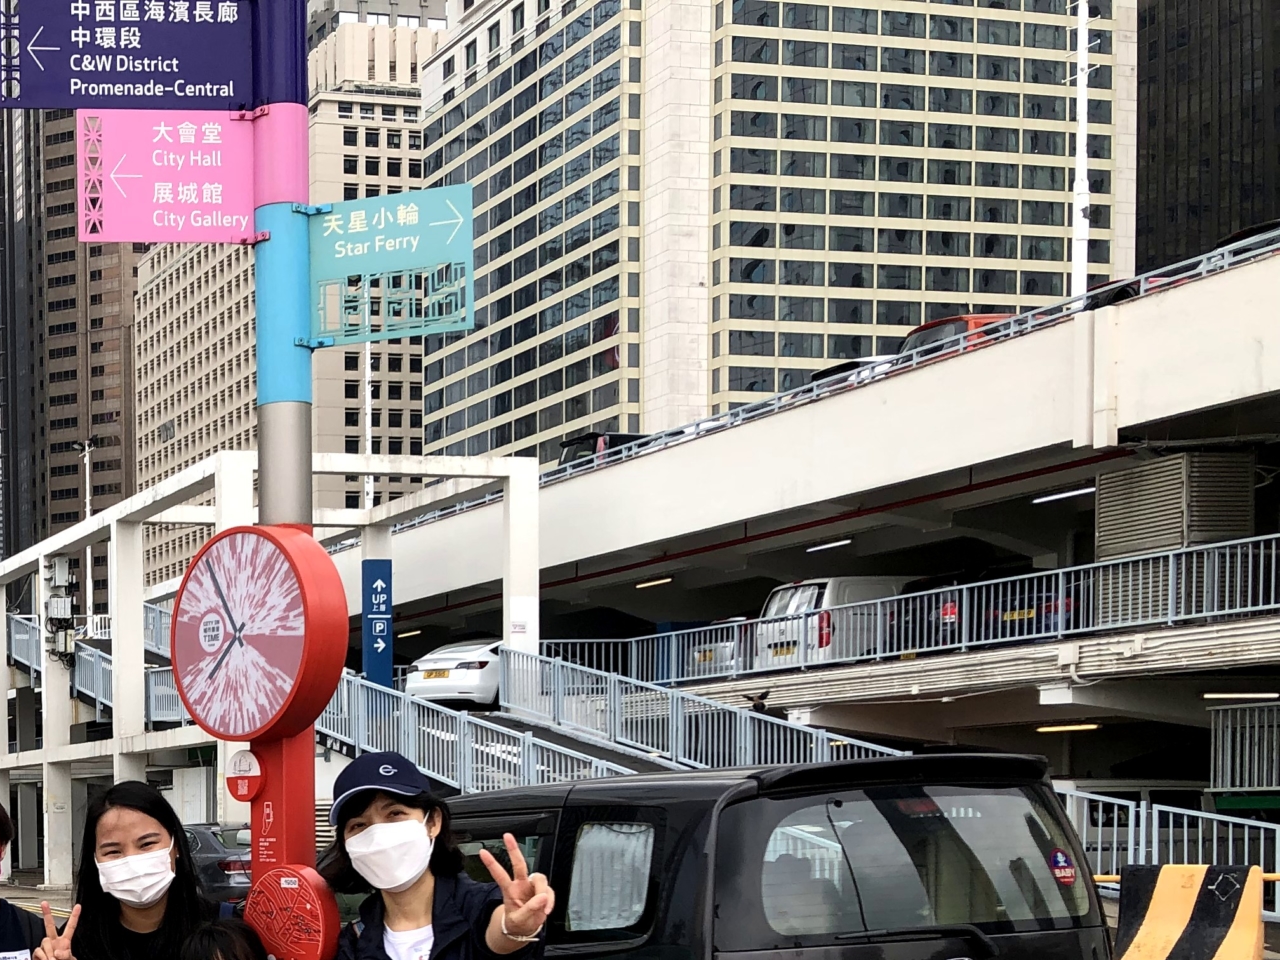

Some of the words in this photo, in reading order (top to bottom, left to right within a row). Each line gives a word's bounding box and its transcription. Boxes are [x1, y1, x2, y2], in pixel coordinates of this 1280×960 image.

[70, 0, 238, 23] 中西區海濱長廊
[70, 26, 141, 49] 中環段
[70, 54, 112, 72] C&W
[116, 55, 179, 72] District
[152, 121, 222, 144] 大會堂
[152, 149, 185, 171] City
[190, 150, 222, 166] Hall
[152, 182, 223, 204] 展城館
[152, 210, 186, 231] City
[190, 210, 249, 232] Gallery
[322, 202, 419, 237] 天星小輪
[334, 240, 371, 258] Star
[375, 235, 420, 253] Ferry
[372, 594, 387, 604] UP
[203, 633, 220, 642] TIME
[375, 624, 385, 633] P
